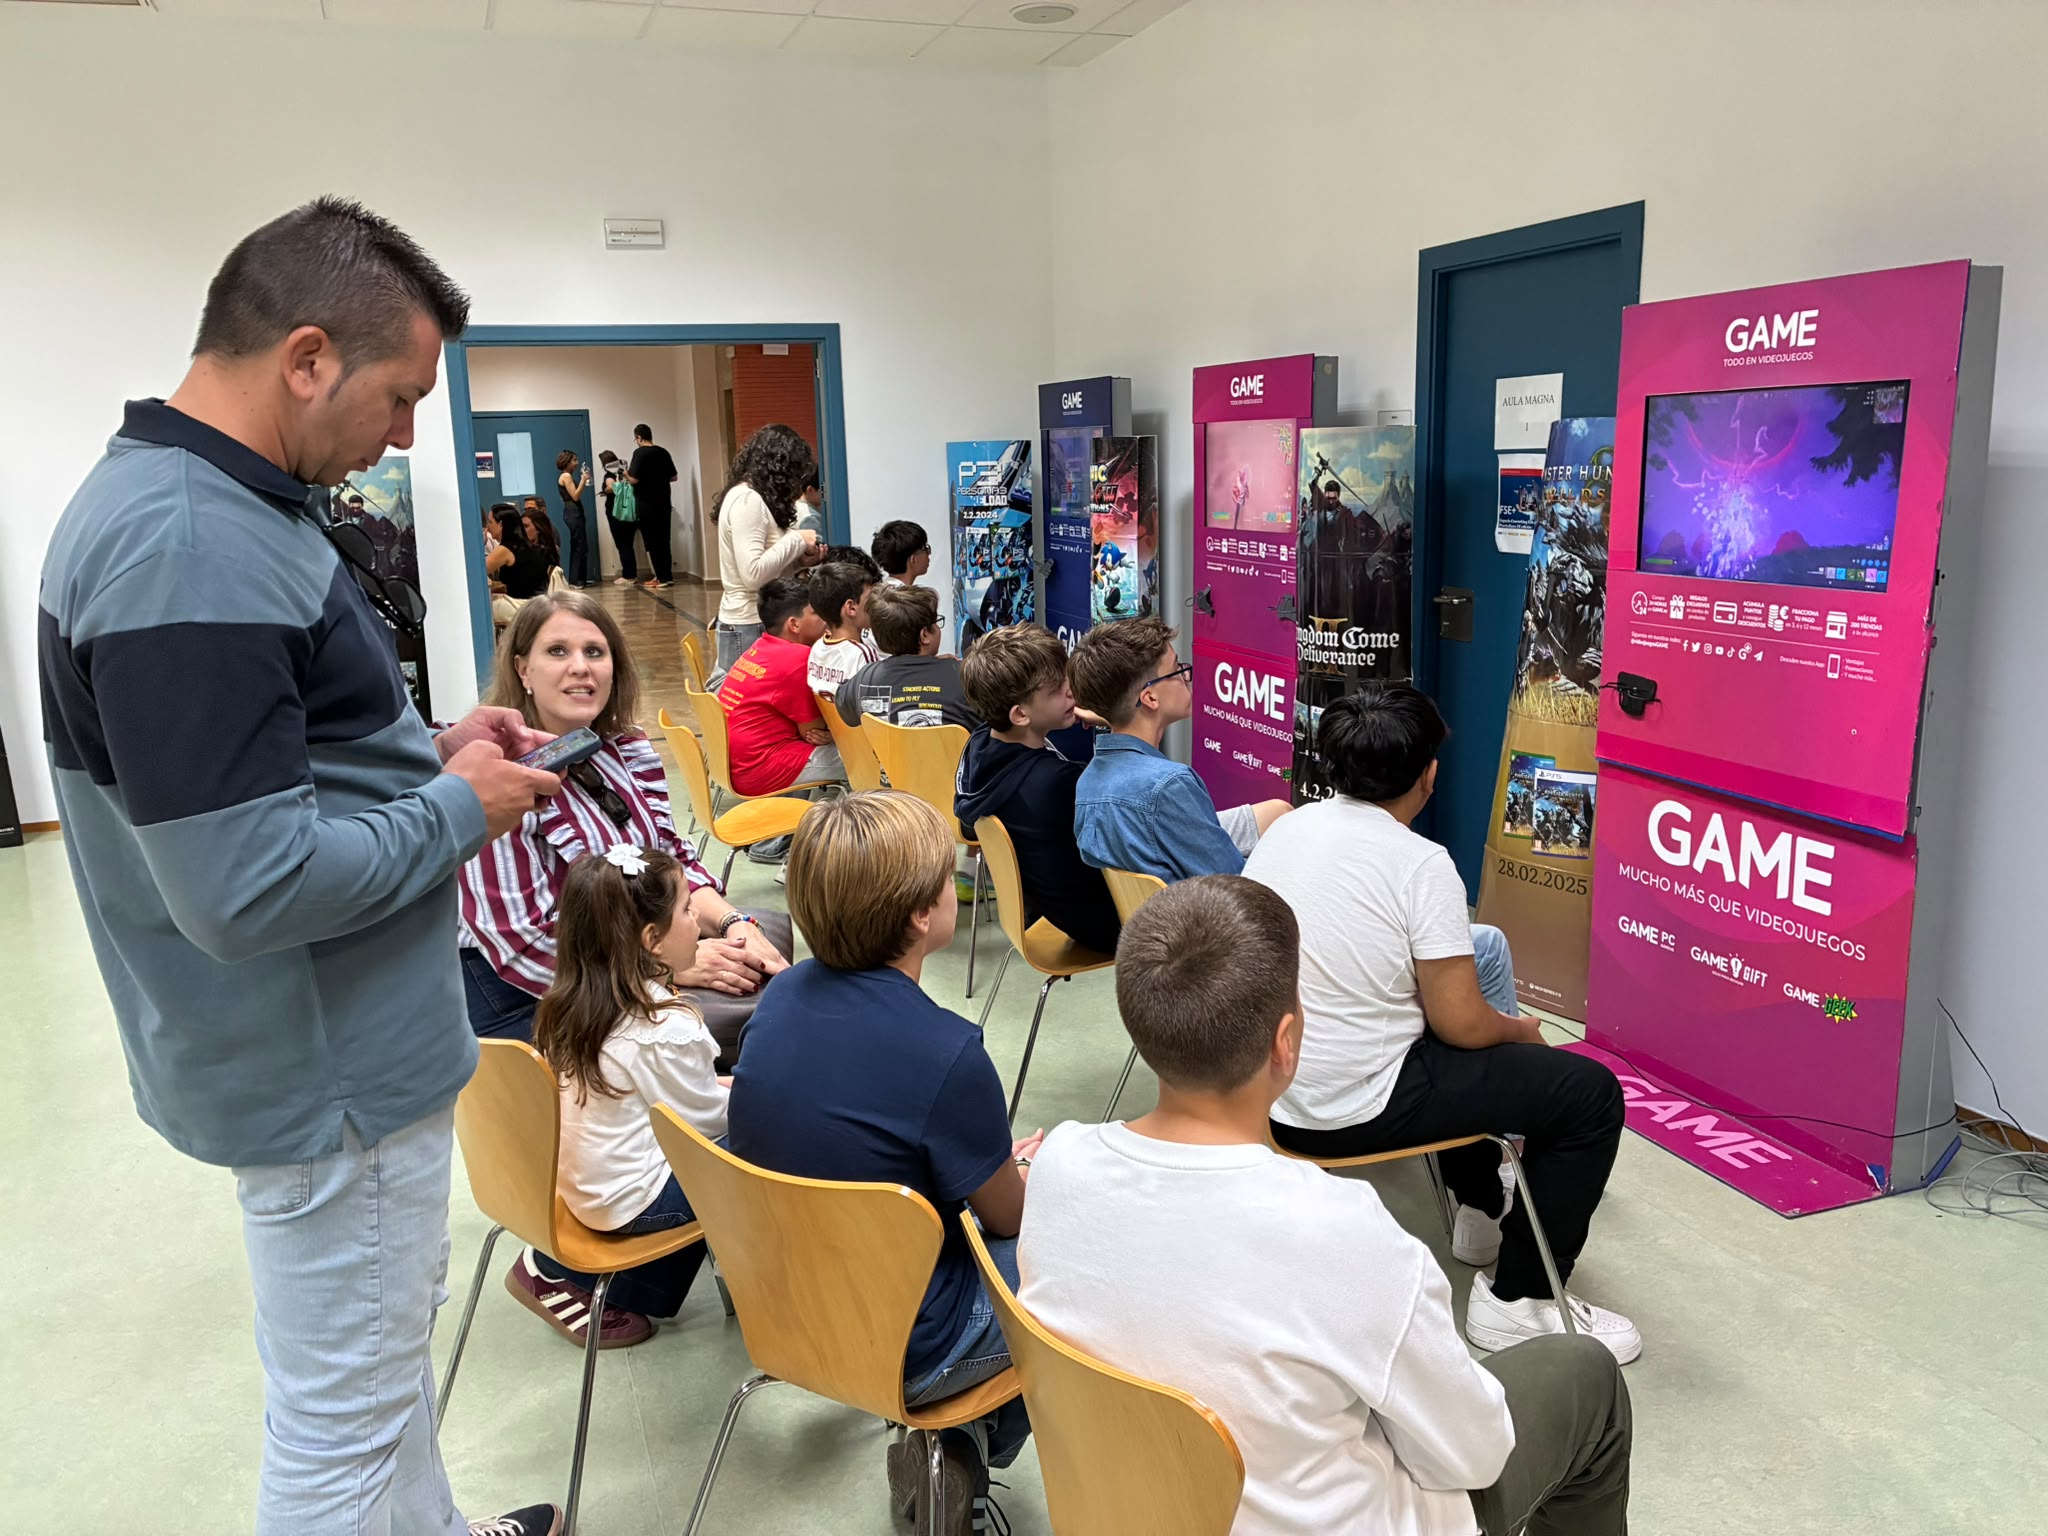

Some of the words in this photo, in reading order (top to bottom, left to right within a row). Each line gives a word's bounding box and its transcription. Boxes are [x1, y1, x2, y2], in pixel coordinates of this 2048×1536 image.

[1725, 309, 1819, 353] GAME
[1723, 358, 1745, 368] TODO
[1746, 356, 1757, 366] EN
[1758, 351, 1814, 364] VIDEOJUEGOS
[1230, 374, 1264, 398] GAME
[1062, 391, 1083, 410] GAME
[1502, 396, 1524, 407] AULA
[1525, 394, 1555, 405] MAGNA
[1341, 626, 1400, 650] Come
[1296, 643, 1376, 666] Deliverance
[1214, 661, 1285, 722] GAME
[1203, 704, 1226, 720] MUCHO
[1225, 712, 1239, 725] MÁS
[1239, 717, 1253, 730] QUE
[1204, 738, 1222, 754] GAME
[1232, 750, 1248, 765] GAME
[1266, 764, 1282, 777] GAME
[1299, 780, 1339, 801] 4.2.2
[1647, 800, 1835, 916] GAME
[1498, 859, 1588, 896] 28.02.2025
[1619, 862, 1671, 893] MUCHO
[1674, 882, 1705, 905] MÁS
[1708, 893, 1742, 918] QUE
[1744, 905, 1866, 961] VIDEOJUEGOS
[1618, 915, 1659, 945] GAME
[1661, 930, 1676, 947] PC
[1690, 946, 1729, 973] GAME
[1743, 965, 1768, 988] GIFT
[1783, 982, 1820, 1008] GAME
[1824, 997, 1856, 1019] GEEK
